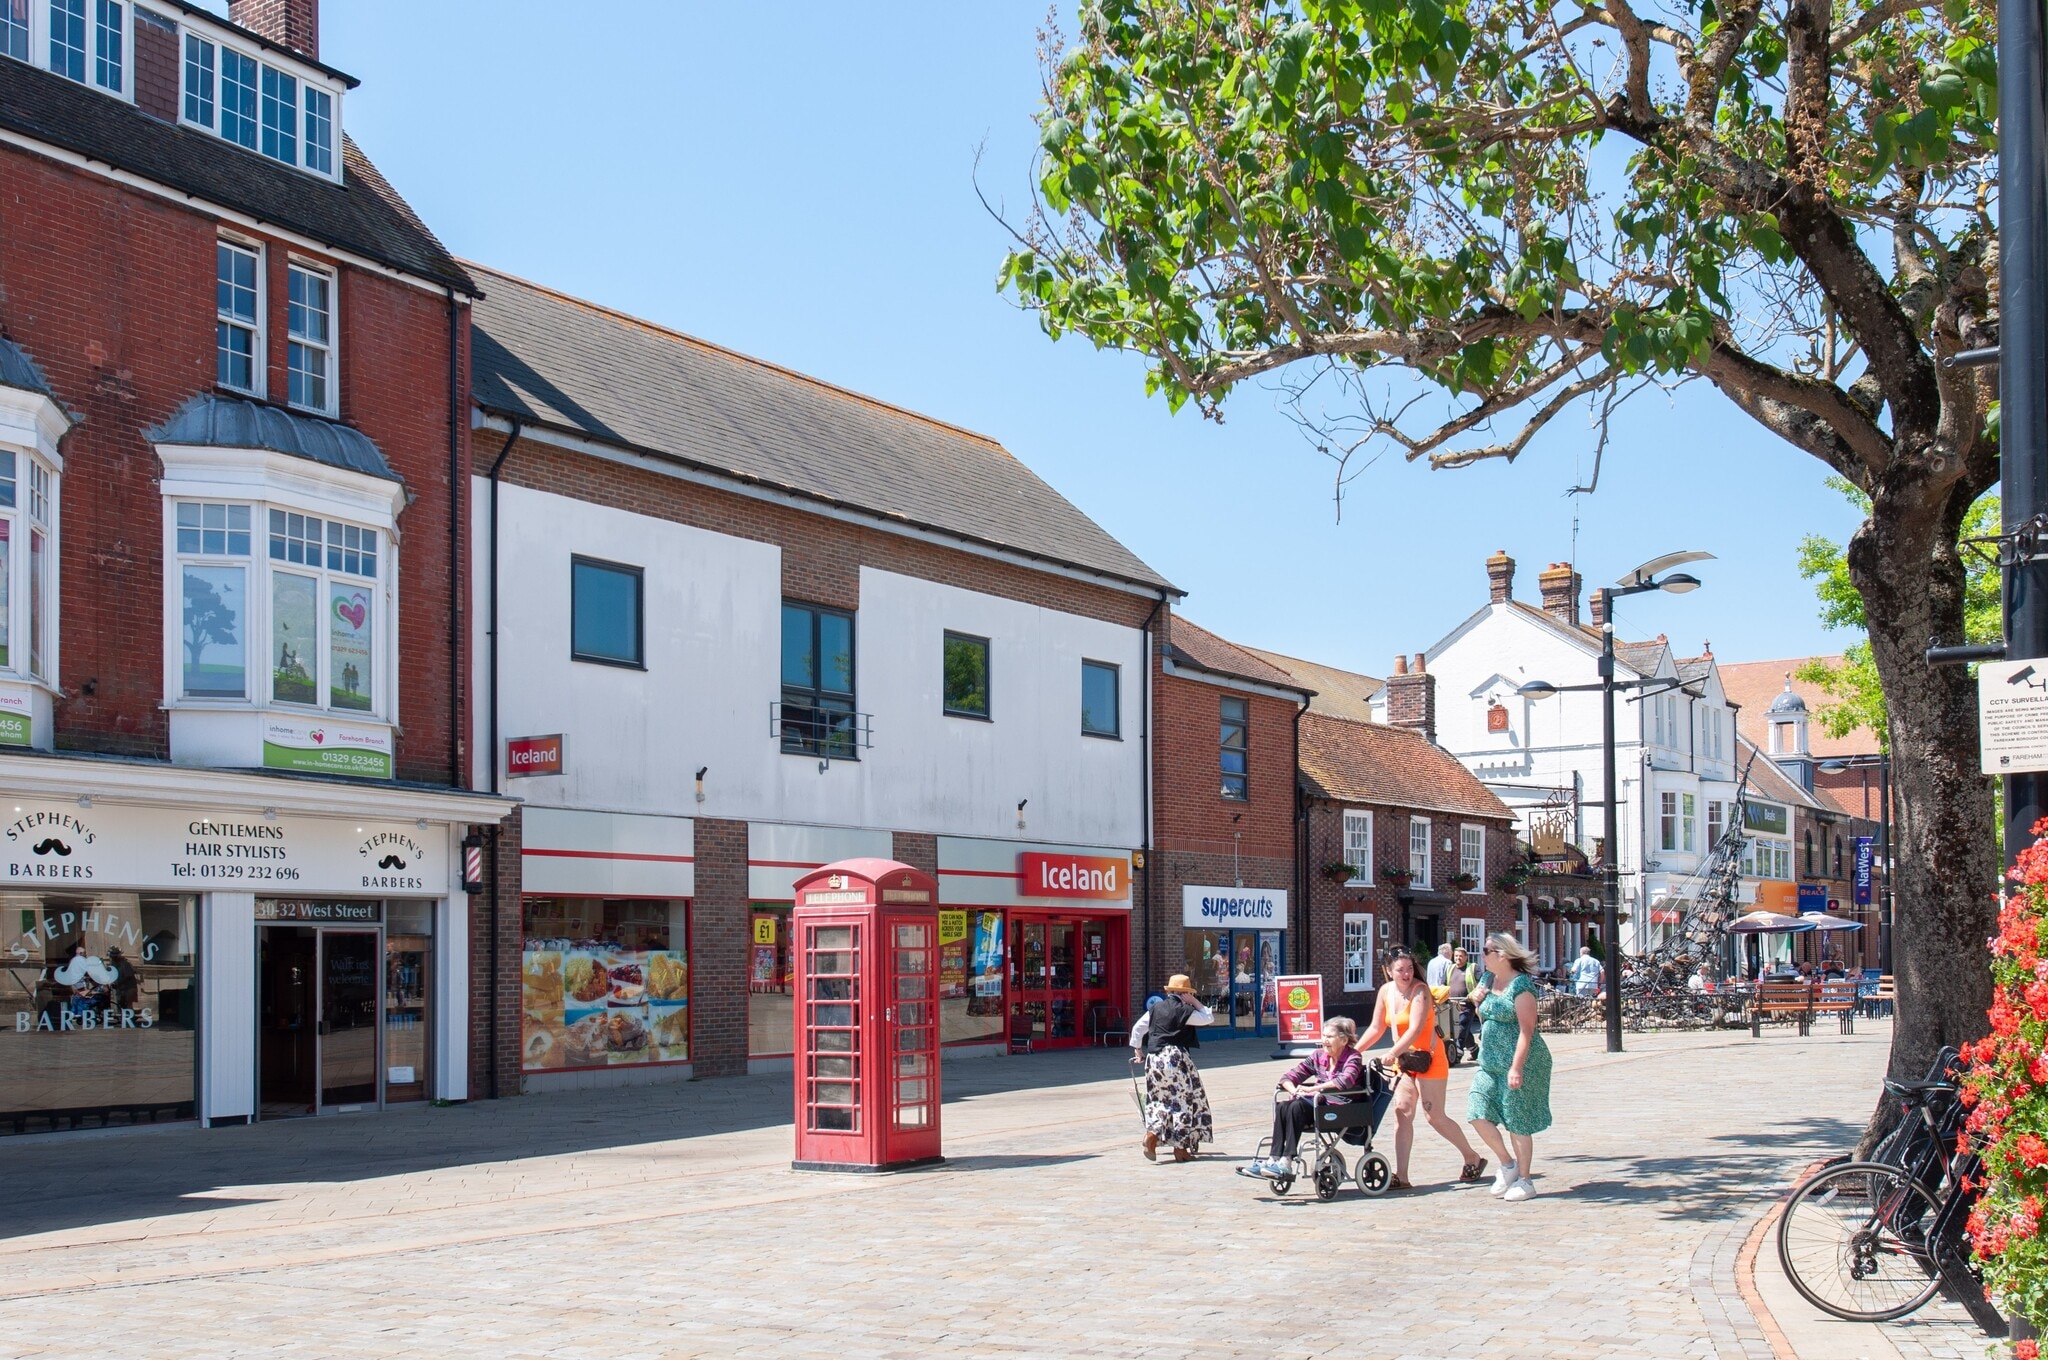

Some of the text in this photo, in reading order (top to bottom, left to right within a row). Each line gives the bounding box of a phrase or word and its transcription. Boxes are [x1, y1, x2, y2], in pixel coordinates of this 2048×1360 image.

[0, 697, 23, 705] ranch
[0, 719, 23, 731] 456
[0, 730, 23, 739] eham
[338, 734, 385, 745] Fareham Branch
[322, 752, 385, 767] 01329 623456
[512, 747, 556, 765] Iceland
[1764, 807, 1776, 821] Beals
[6, 812, 97, 845] STEPHEN'S
[188, 821, 283, 840] GENTLEMENS
[185, 842, 286, 860] HAIR STYLISTS
[358, 832, 424, 860] STEPHEN'S
[10, 863, 93, 879] BARBERS
[171, 862, 300, 880] Tel: 01329 232 696
[1558, 859, 1579, 874] OWN
[1857, 842, 1870, 887] NatWest
[362, 875, 422, 889] BARBERS
[1041, 861, 1116, 891] Iceland
[805, 892, 864, 904] TELEPHONE
[256, 902, 373, 918] 30-32 West Street
[1201, 895, 1273, 923] supercuts
[10, 911, 159, 964] STEPHEN'S
[760, 925, 770, 939] £1
[16, 1007, 154, 1033] BARBERS
